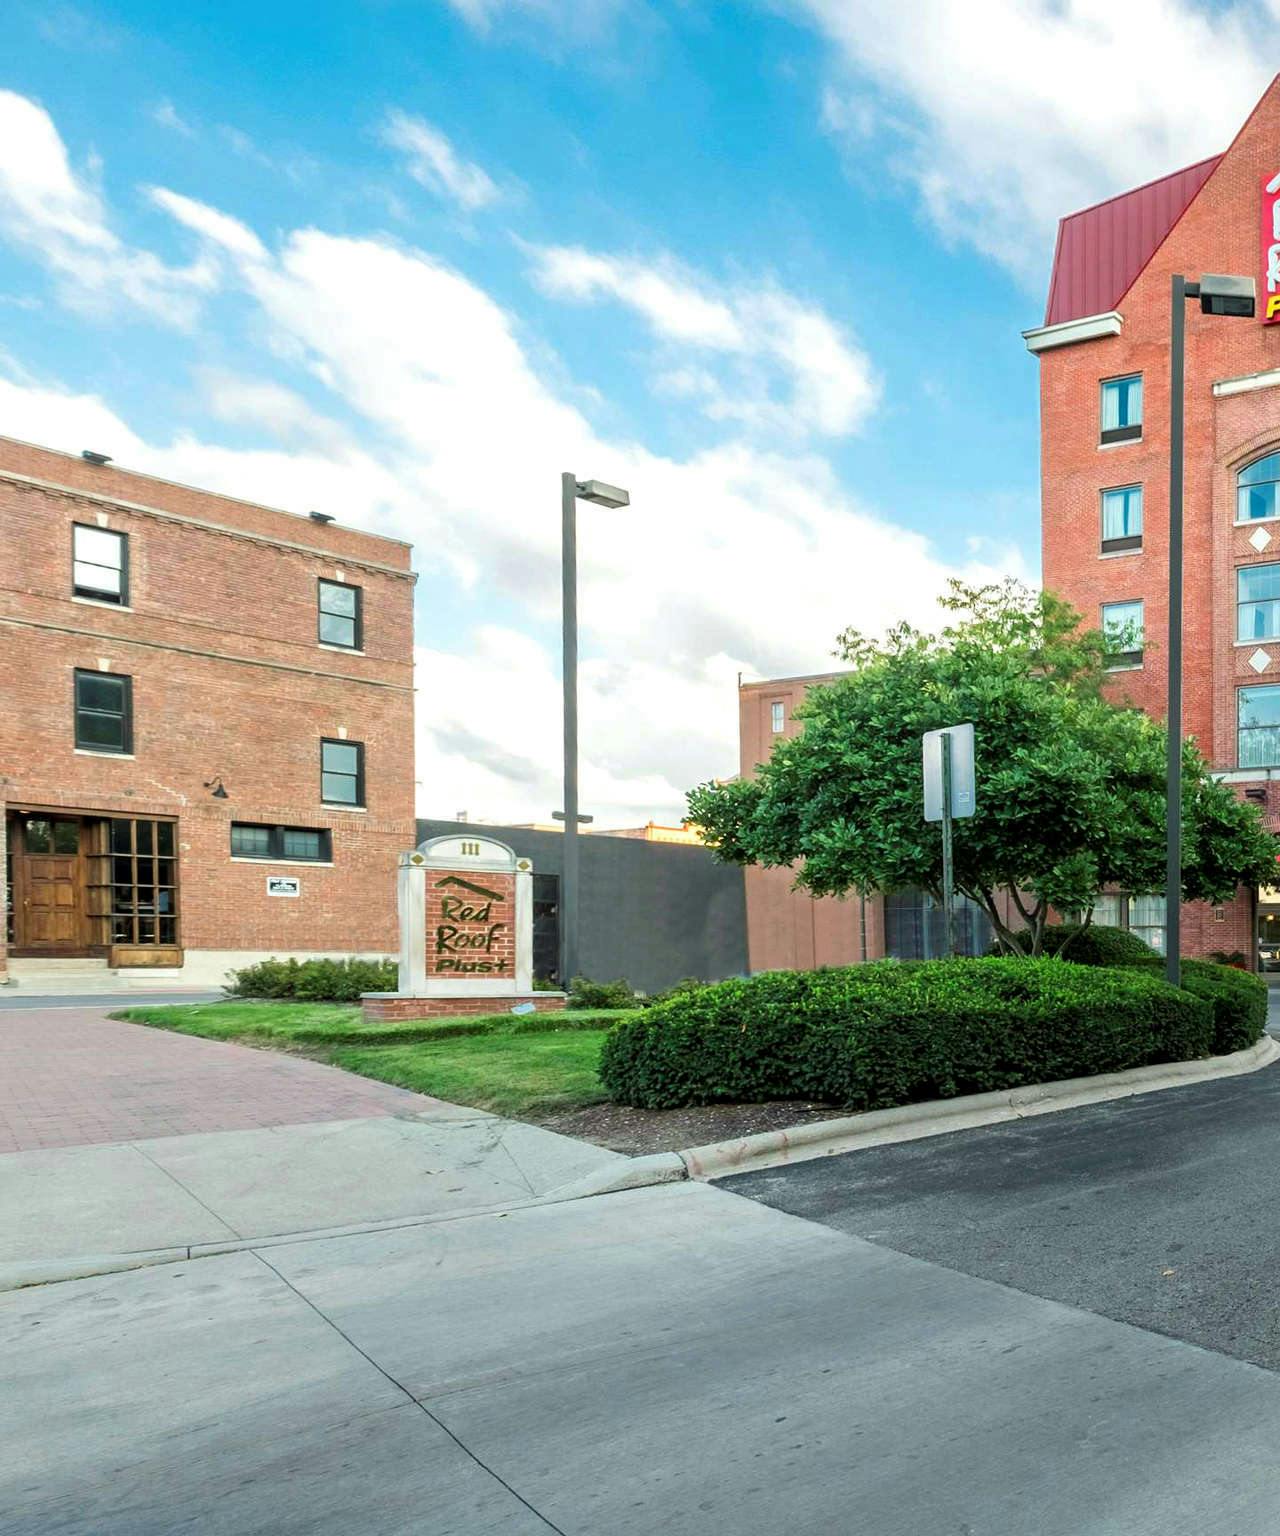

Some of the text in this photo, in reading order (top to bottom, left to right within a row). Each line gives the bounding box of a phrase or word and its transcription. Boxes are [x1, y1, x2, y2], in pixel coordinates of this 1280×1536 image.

[441, 895, 492, 923] Red
[435, 923, 505, 954] Roof
[435, 958, 509, 973] Plus+
